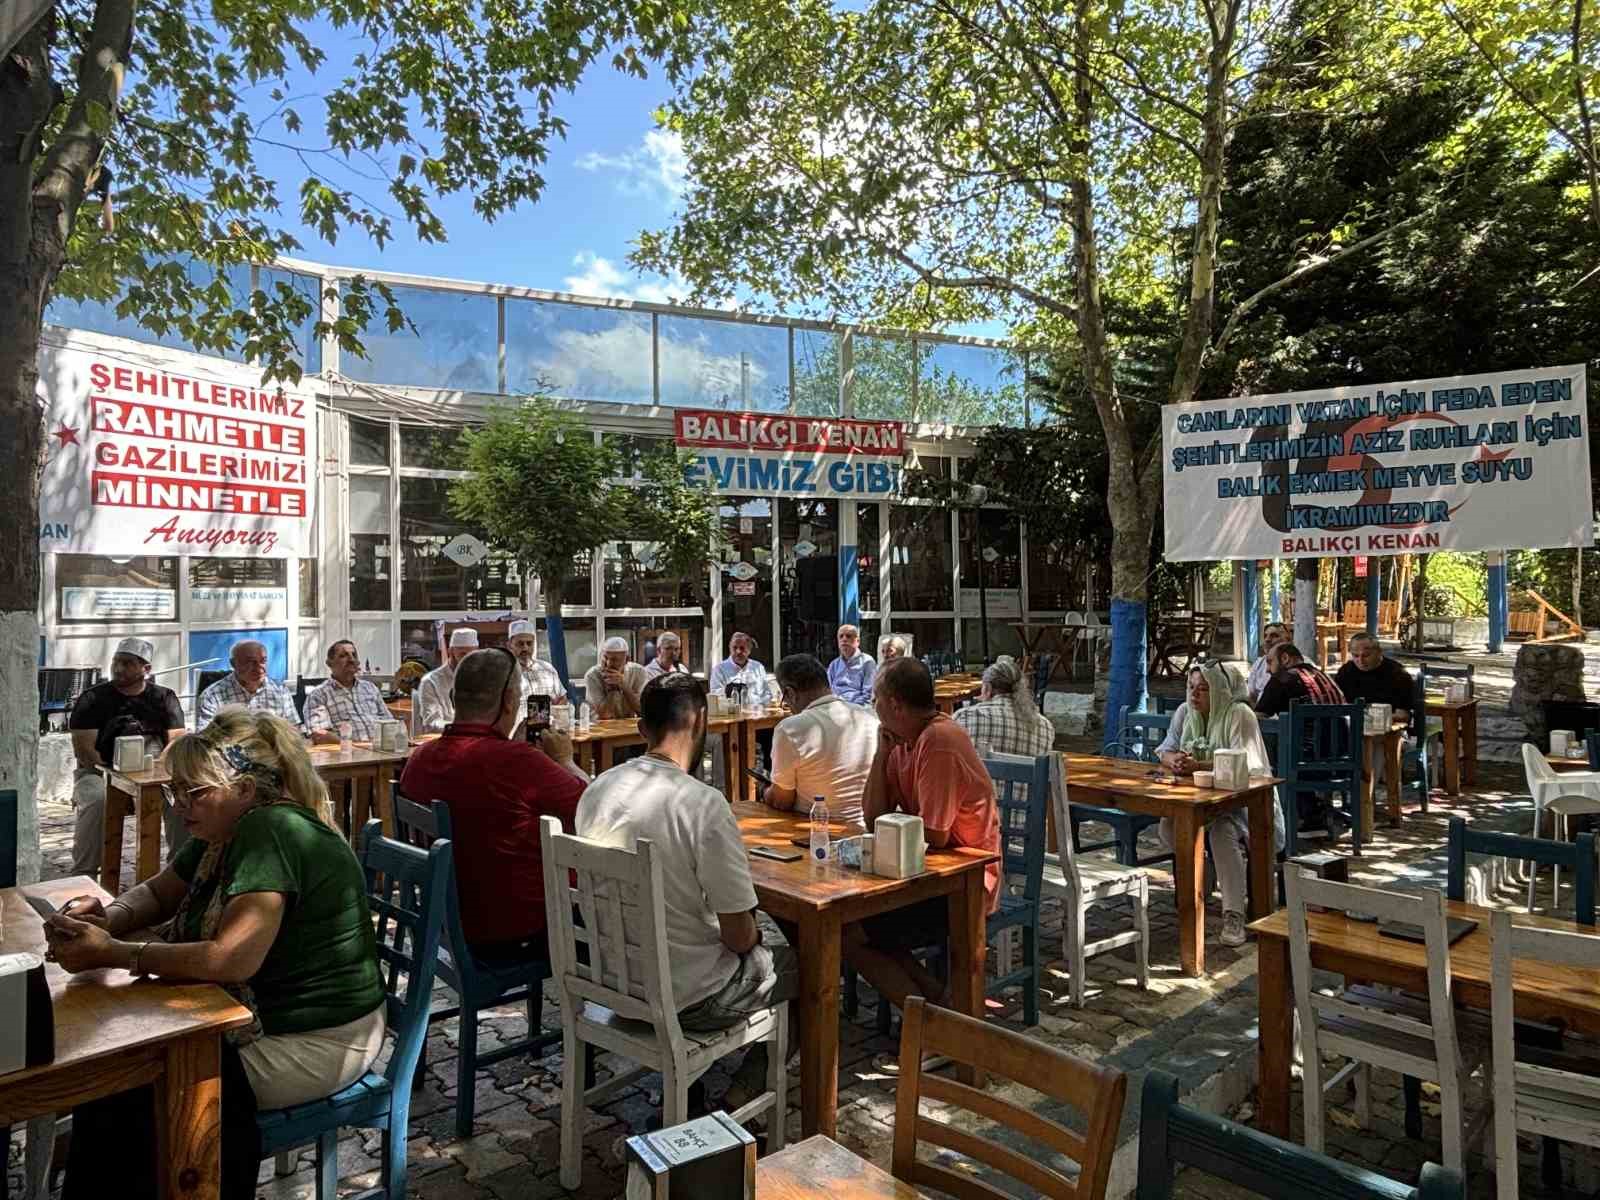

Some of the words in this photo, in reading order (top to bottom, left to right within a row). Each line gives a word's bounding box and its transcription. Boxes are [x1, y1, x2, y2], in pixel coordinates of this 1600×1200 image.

[90, 363, 305, 419] ŞEHİTLERİMİZ
[1178, 404, 1292, 433] CANLARINI
[1296, 397, 1370, 423] VATAN
[1377, 388, 1425, 420] İÇİN
[1432, 386, 1497, 411] FEDA
[1502, 378, 1571, 407] EDEN
[95, 400, 300, 453] RAHMETLE
[682, 416, 797, 449] BALIKÇI
[808, 421, 898, 448] KENAN
[1173, 432, 1345, 472] ŞEHİTLERİMİZİN
[1351, 427, 1404, 454] AZİZ
[1409, 421, 1518, 450] RUHLARI
[1525, 412, 1581, 446] İÇİN
[95, 442, 305, 483] GAZİLERİMİZİ
[684, 456, 817, 491] EVİMİZ
[1218, 475, 1280, 498] BALIK
[1289, 471, 1367, 494] EKMEK
[1373, 463, 1456, 489] MEYVE
[1462, 457, 1533, 483] SUYU
[97, 476, 300, 515] MİNNETLE
[1285, 500, 1450, 529] İKRAMIMIZDIR
[40, 523, 68, 538] AN
[144, 515, 279, 553] Anıyoruz
[1282, 536, 1360, 553] BALIKÇI
[1368, 533, 1440, 550] KENAN
